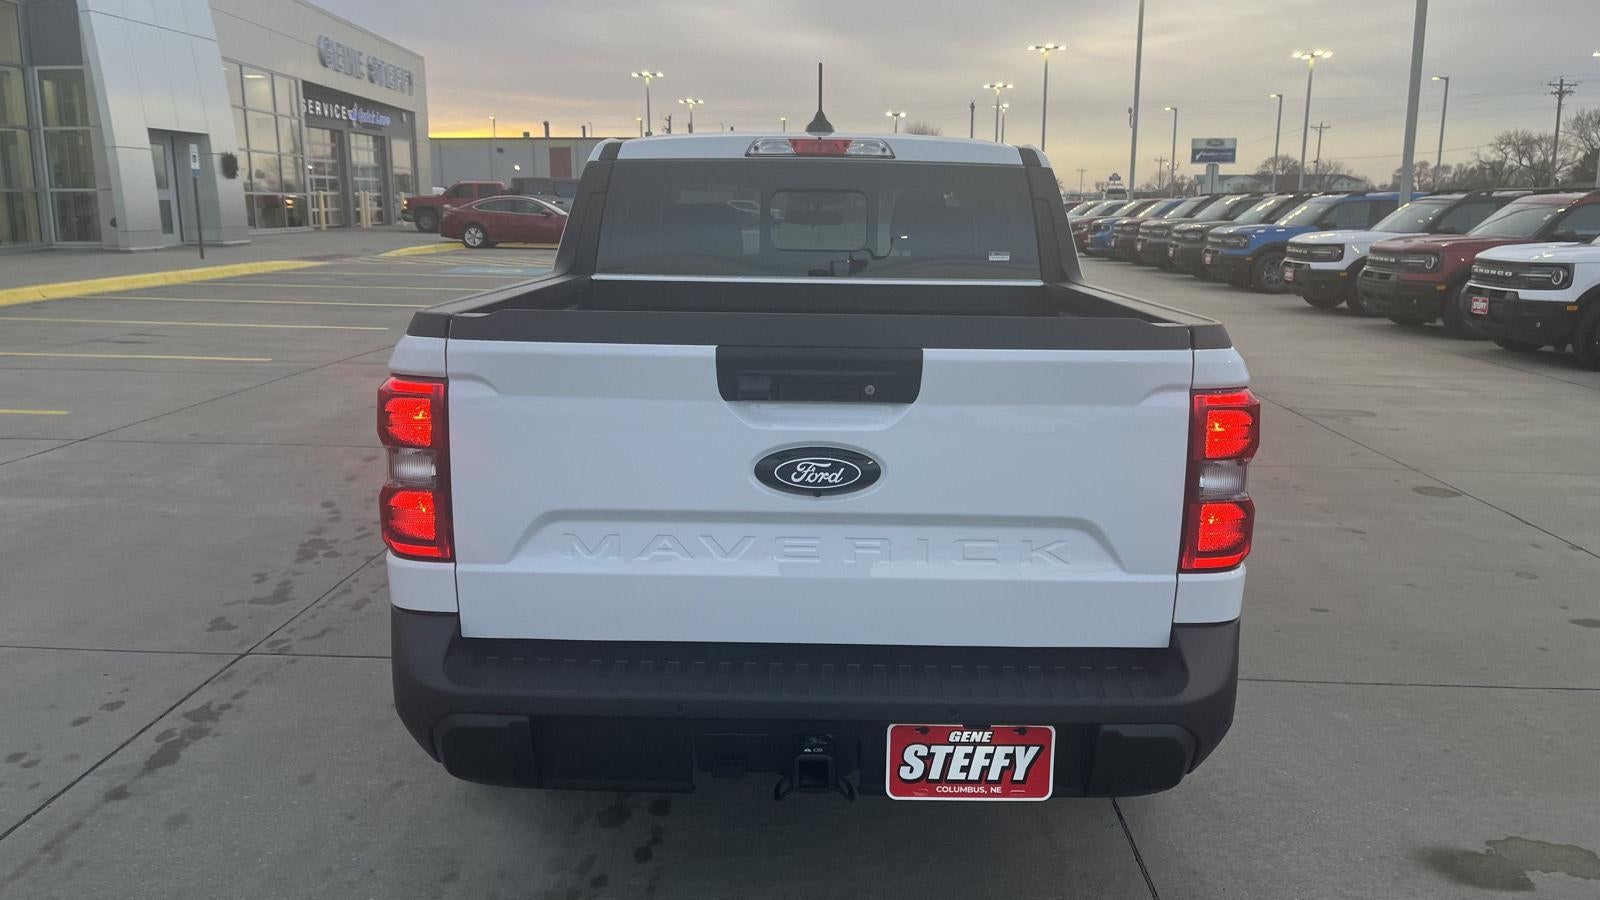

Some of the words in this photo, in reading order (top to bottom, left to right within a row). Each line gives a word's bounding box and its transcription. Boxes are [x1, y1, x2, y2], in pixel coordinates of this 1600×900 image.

[318, 34, 365, 80] GENE
[302, 98, 348, 121] SERVICE
[790, 459, 845, 486] Ford
[561, 531, 1073, 567] MAVERICK
[948, 730, 992, 743] GENE
[899, 743, 1042, 782] STEFFY
[935, 785, 987, 795] COLUMBUS,
[990, 786, 1003, 794] NE
